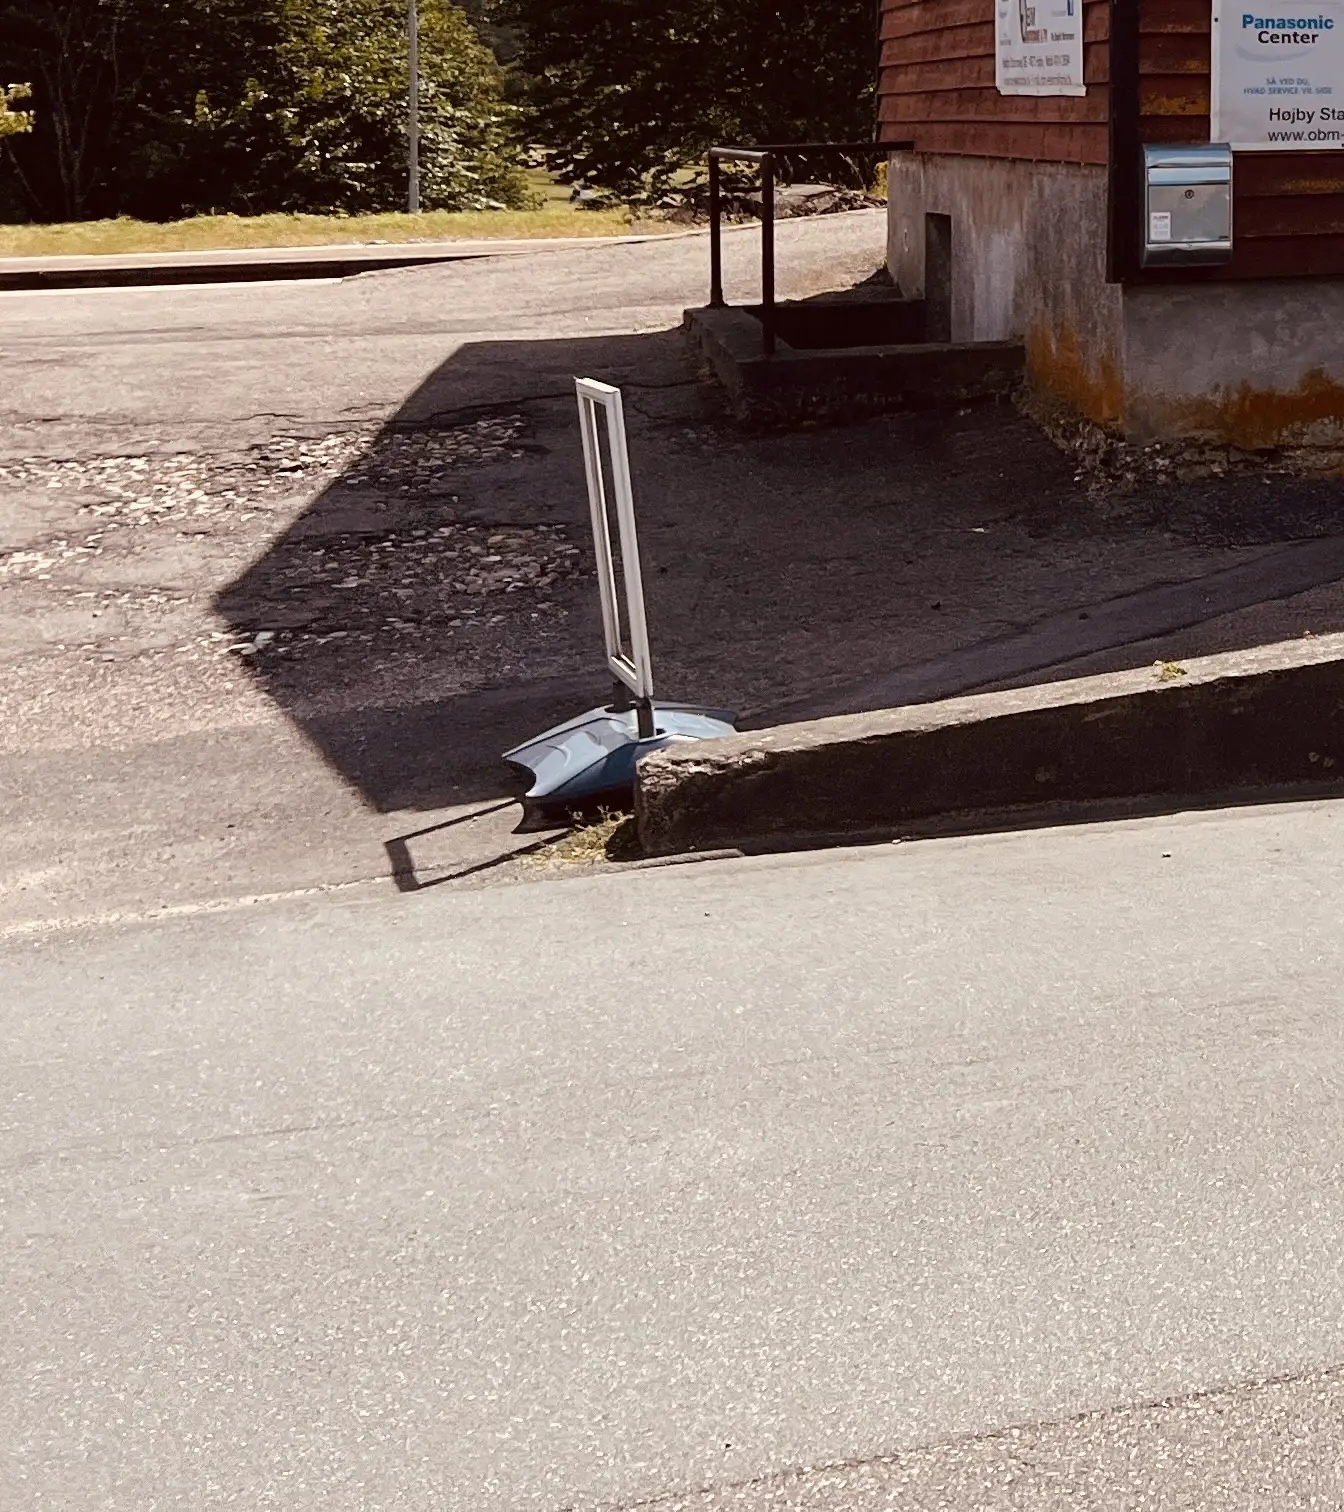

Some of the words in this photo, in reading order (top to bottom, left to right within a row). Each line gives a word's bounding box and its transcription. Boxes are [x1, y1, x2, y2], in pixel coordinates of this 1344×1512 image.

[1242, 14, 1335, 30] Panasonic
[1257, 30, 1320, 44] Center
[1269, 107, 1315, 124] Højby
